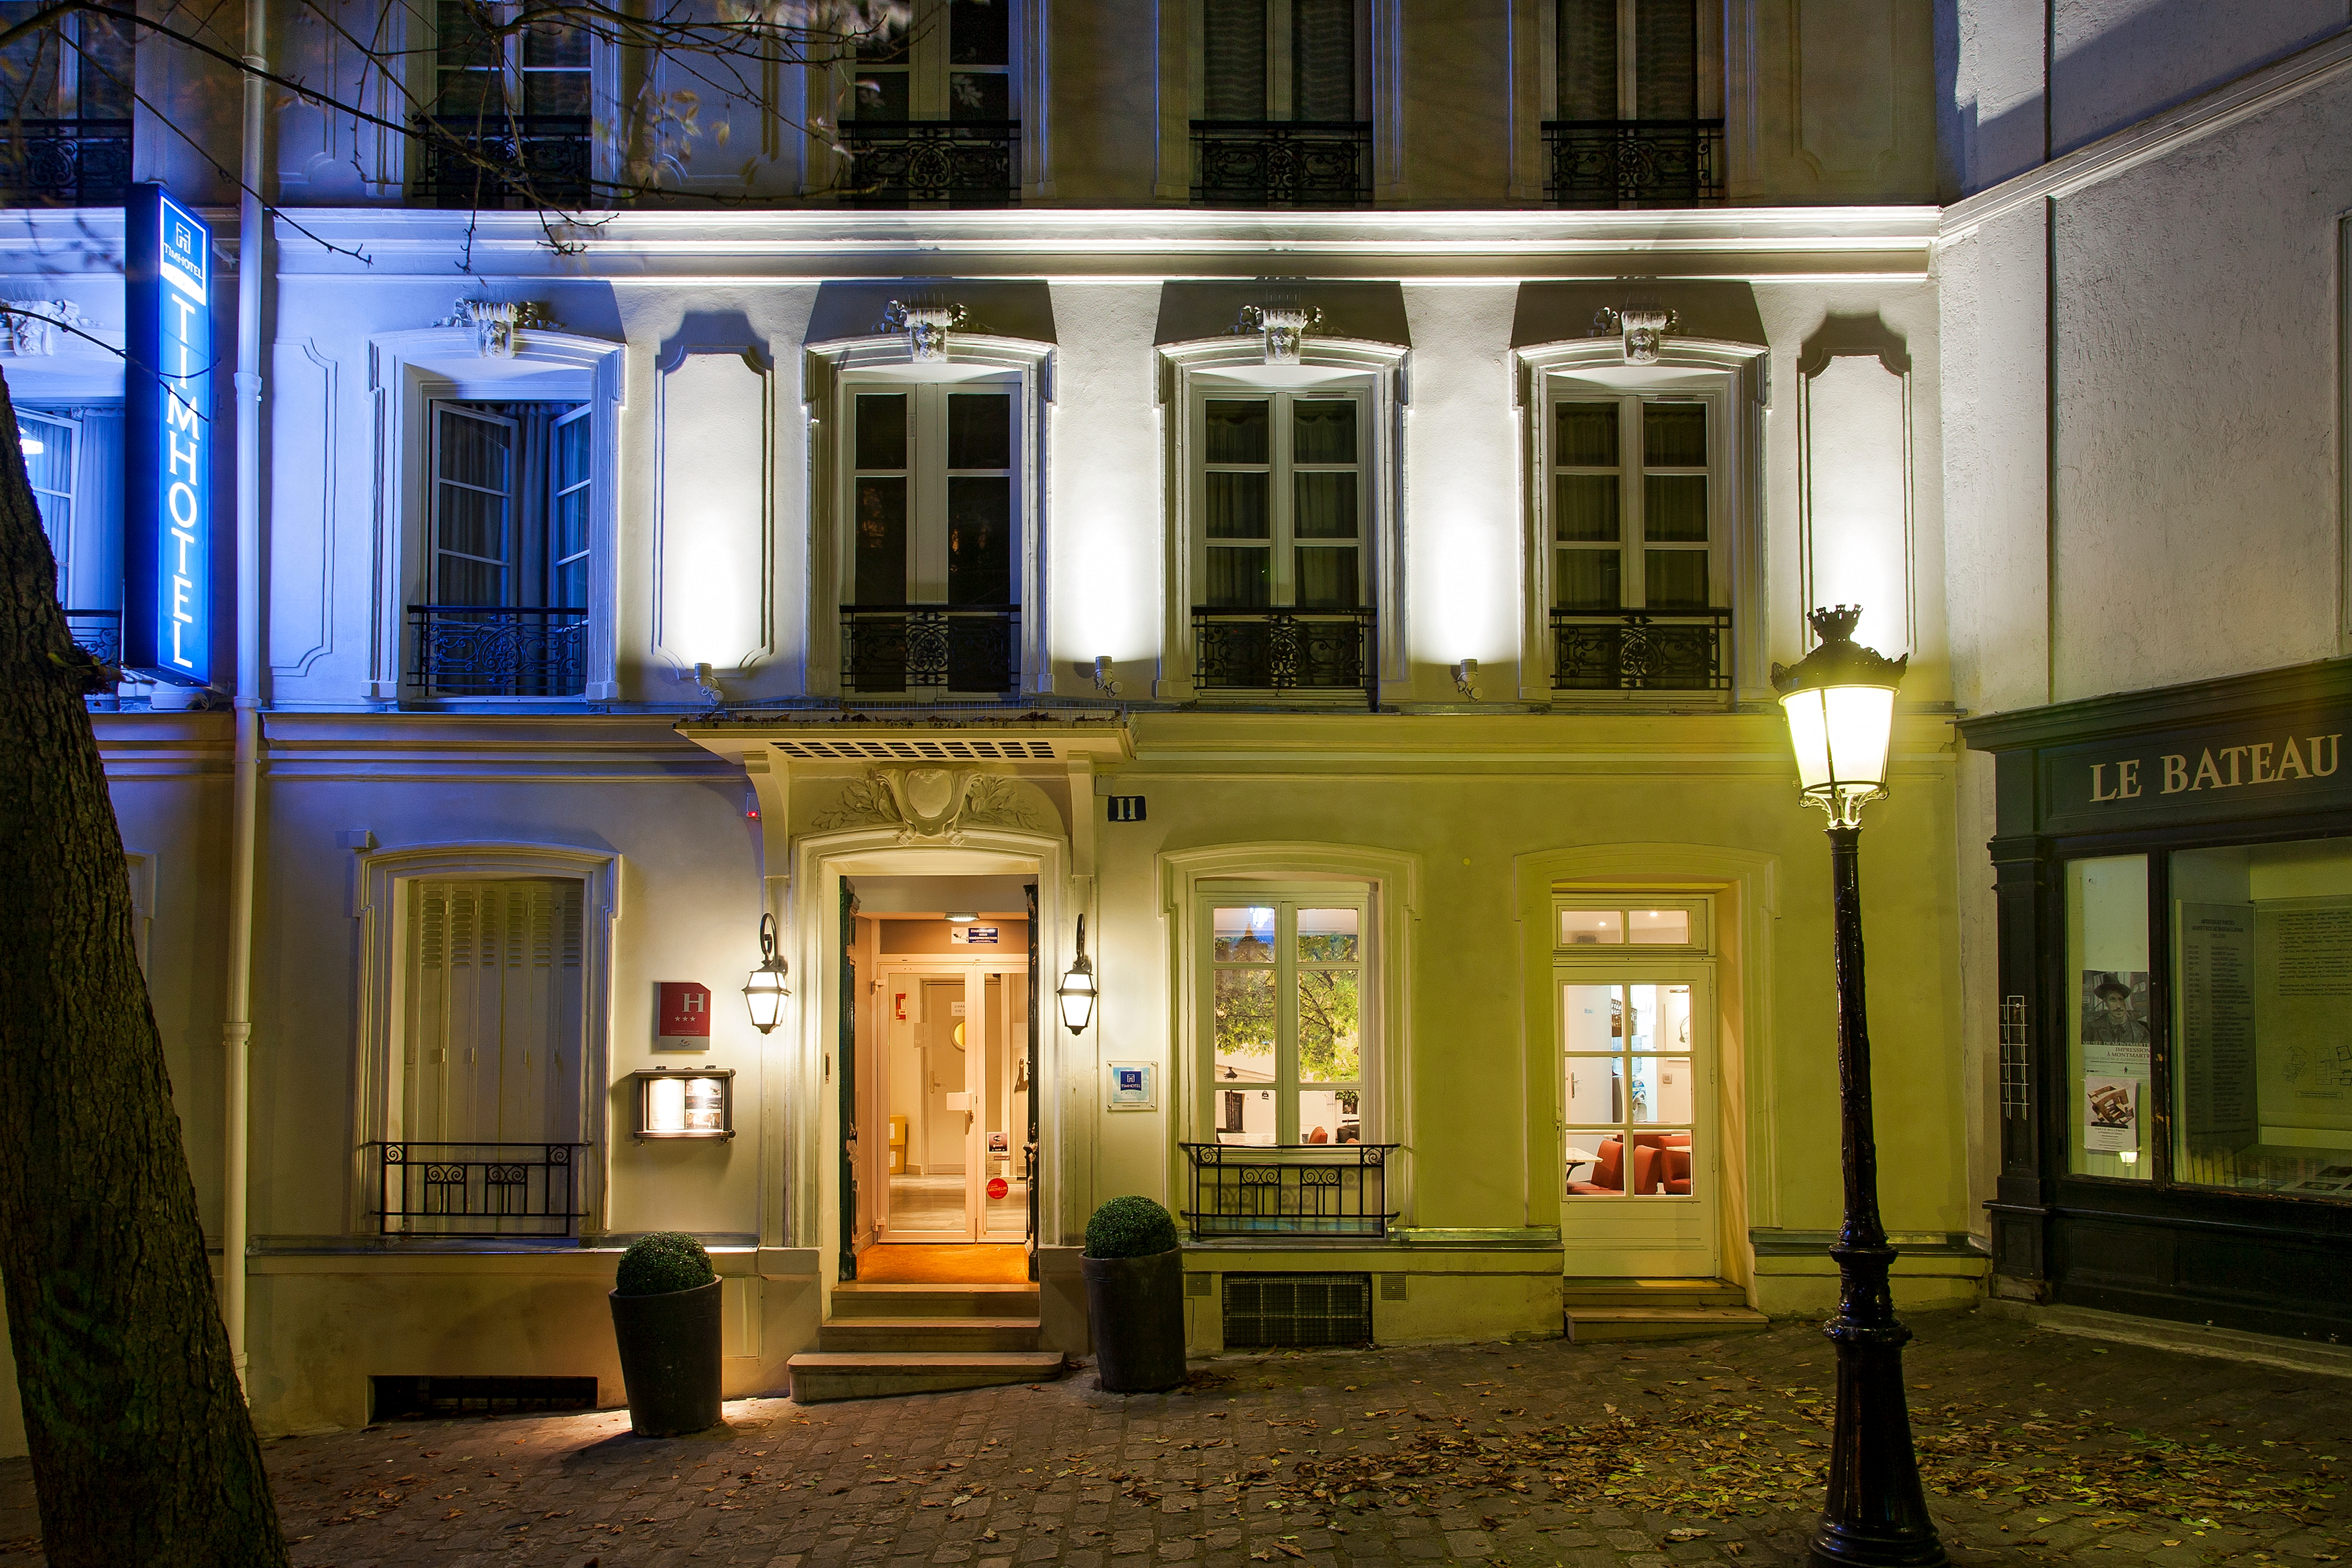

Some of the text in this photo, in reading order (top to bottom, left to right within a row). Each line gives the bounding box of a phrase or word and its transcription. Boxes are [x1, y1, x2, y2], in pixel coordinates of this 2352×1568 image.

[164, 242, 203, 279] TIMHOTEL
[166, 293, 200, 668] TIMHOTEL
[2089, 733, 2343, 802] LE BATEAU
[682, 993, 706, 1013] H
